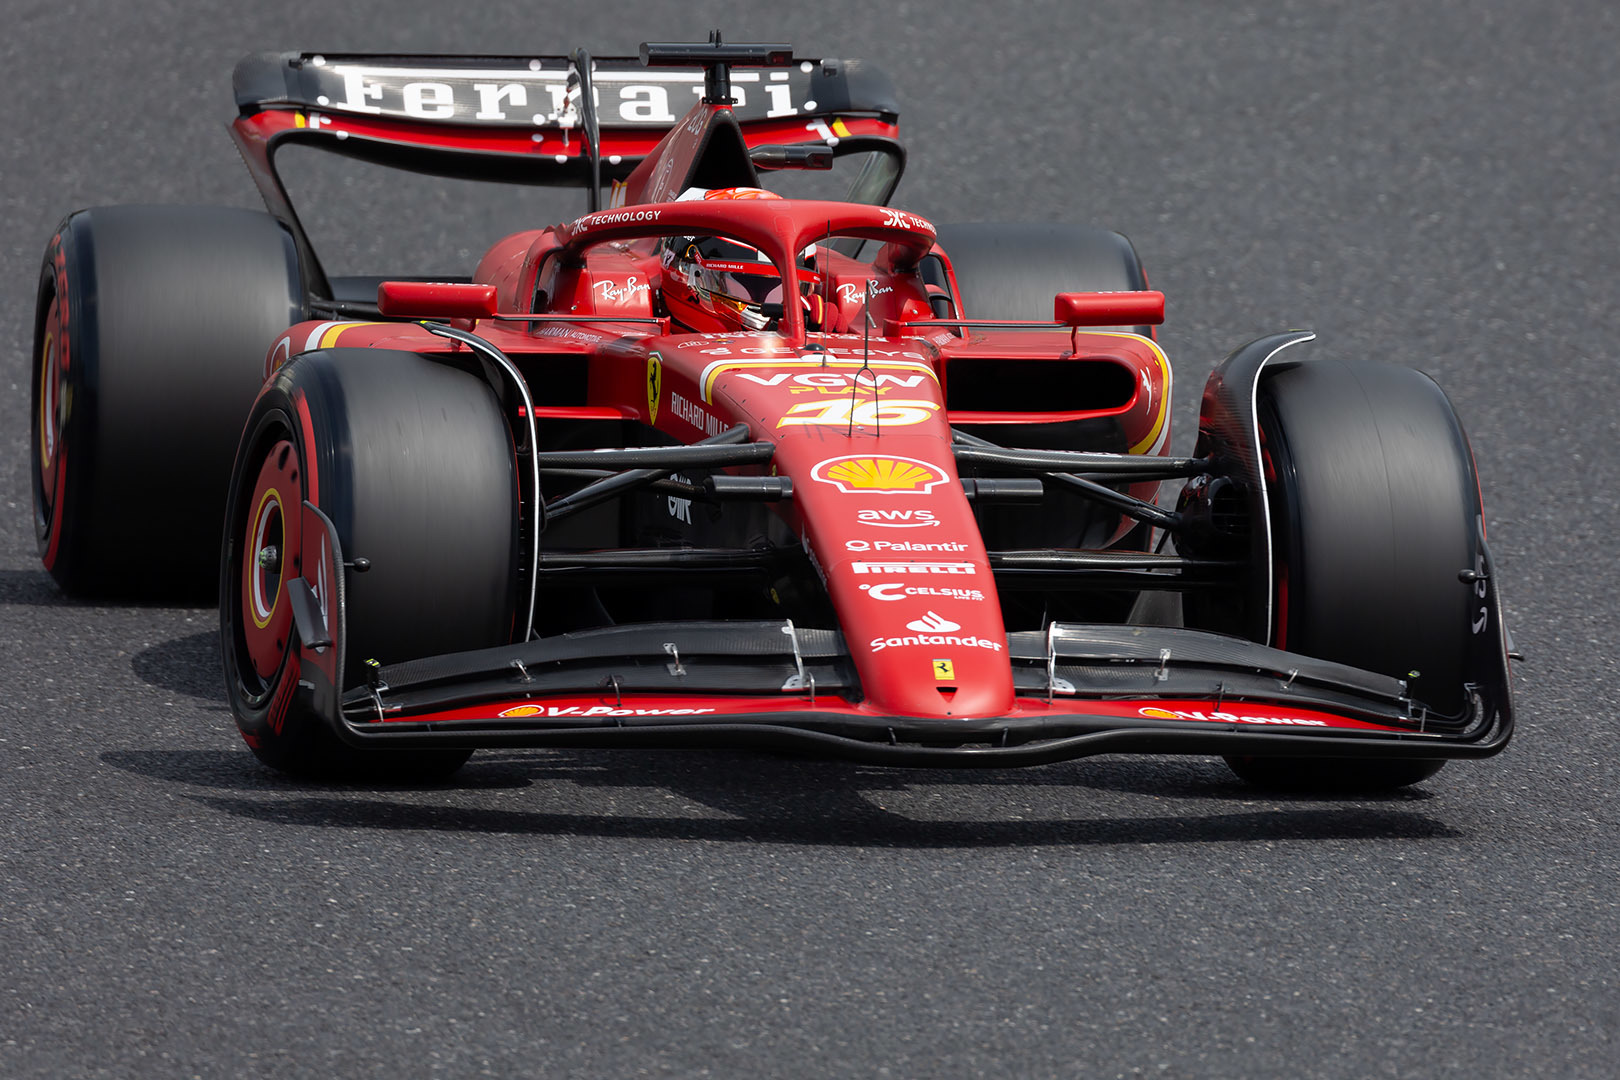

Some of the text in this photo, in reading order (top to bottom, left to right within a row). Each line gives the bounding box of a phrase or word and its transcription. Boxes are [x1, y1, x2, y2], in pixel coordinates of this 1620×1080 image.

[591, 210, 662, 226] TECHNOLOGY
[740, 347, 926, 361] GEESYS
[735, 373, 926, 388] VGW
[787, 385, 893, 396] PLAY
[671, 391, 705, 431] RICHARD
[776, 397, 941, 429] 16
[857, 509, 936, 521] aws
[874, 541, 969, 553] Palantir
[851, 562, 976, 575] PIRELLI
[904, 586, 982, 598] CELSIUS
[869, 634, 1003, 653] Santander
[546, 705, 716, 717] V-Power
